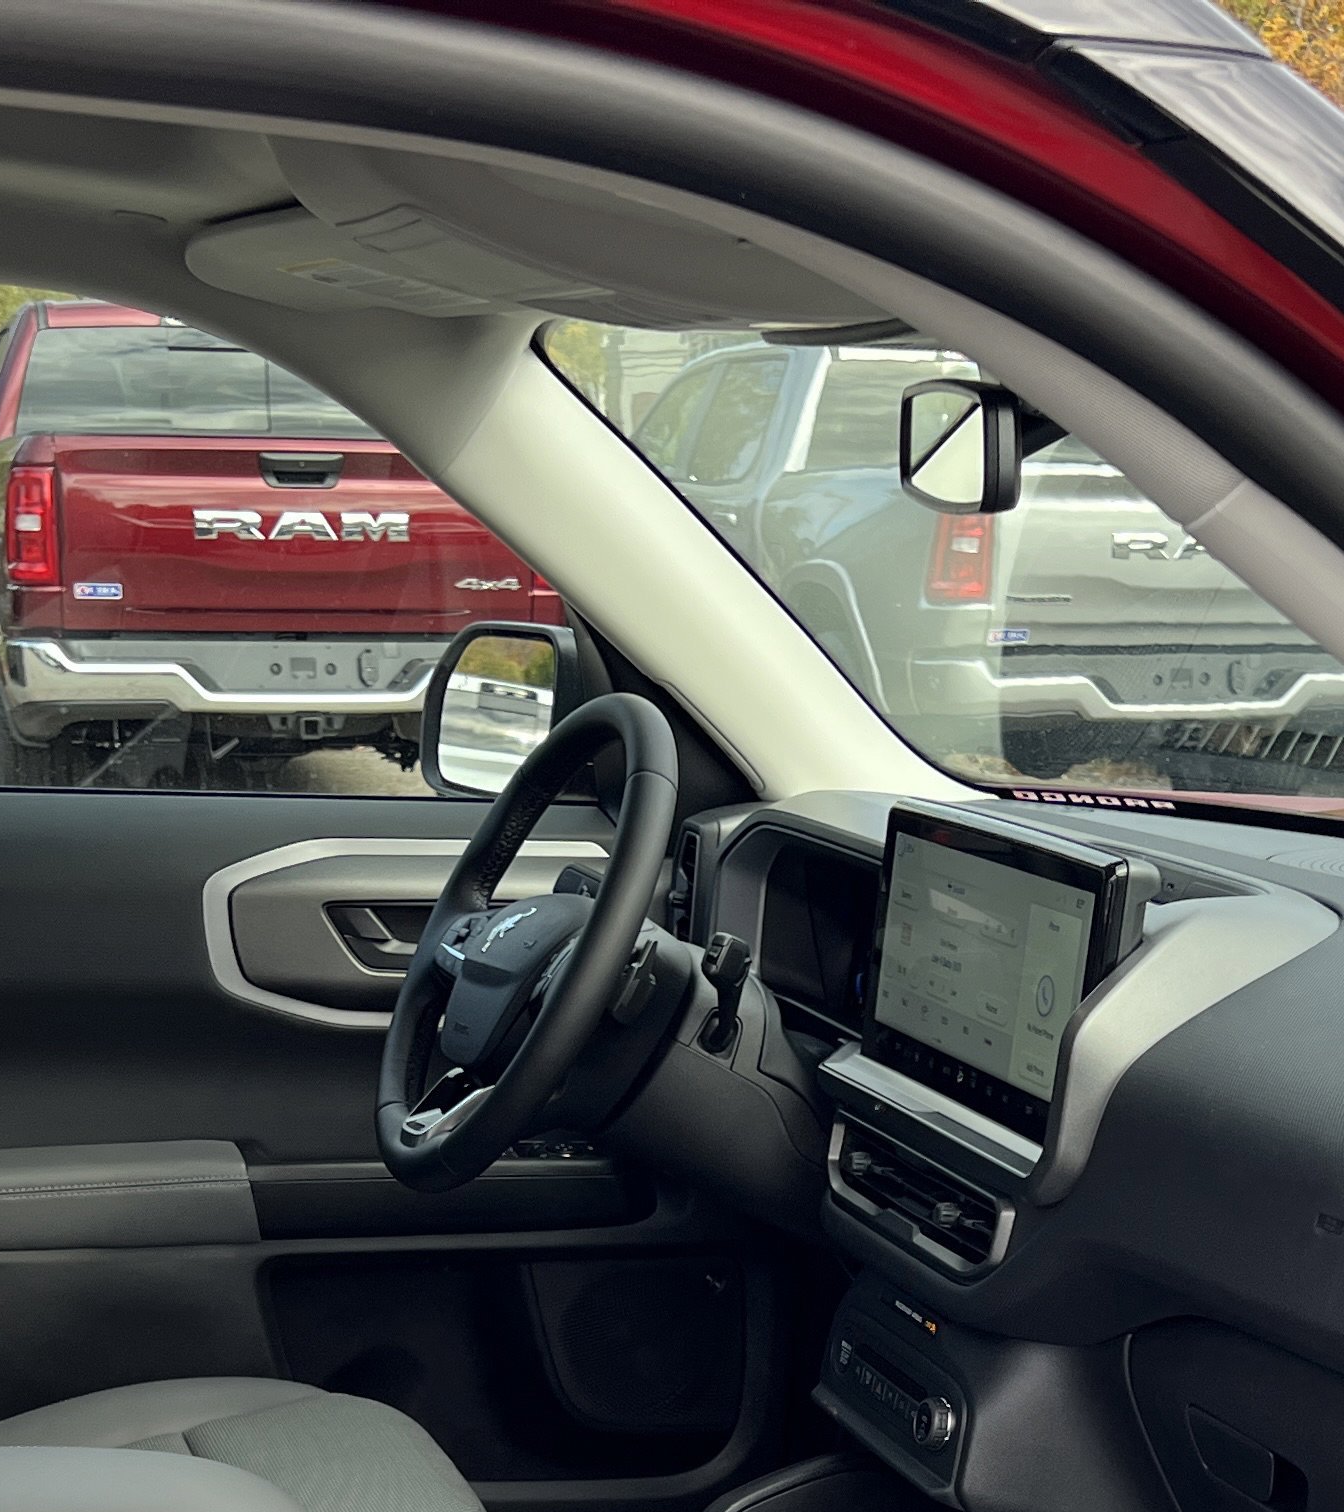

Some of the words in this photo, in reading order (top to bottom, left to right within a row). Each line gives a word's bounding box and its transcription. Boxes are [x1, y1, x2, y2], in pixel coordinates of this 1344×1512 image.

[192, 509, 410, 542] RAM
[1111, 532, 1208, 560] RA
[453, 578, 522, 591] 4x4
